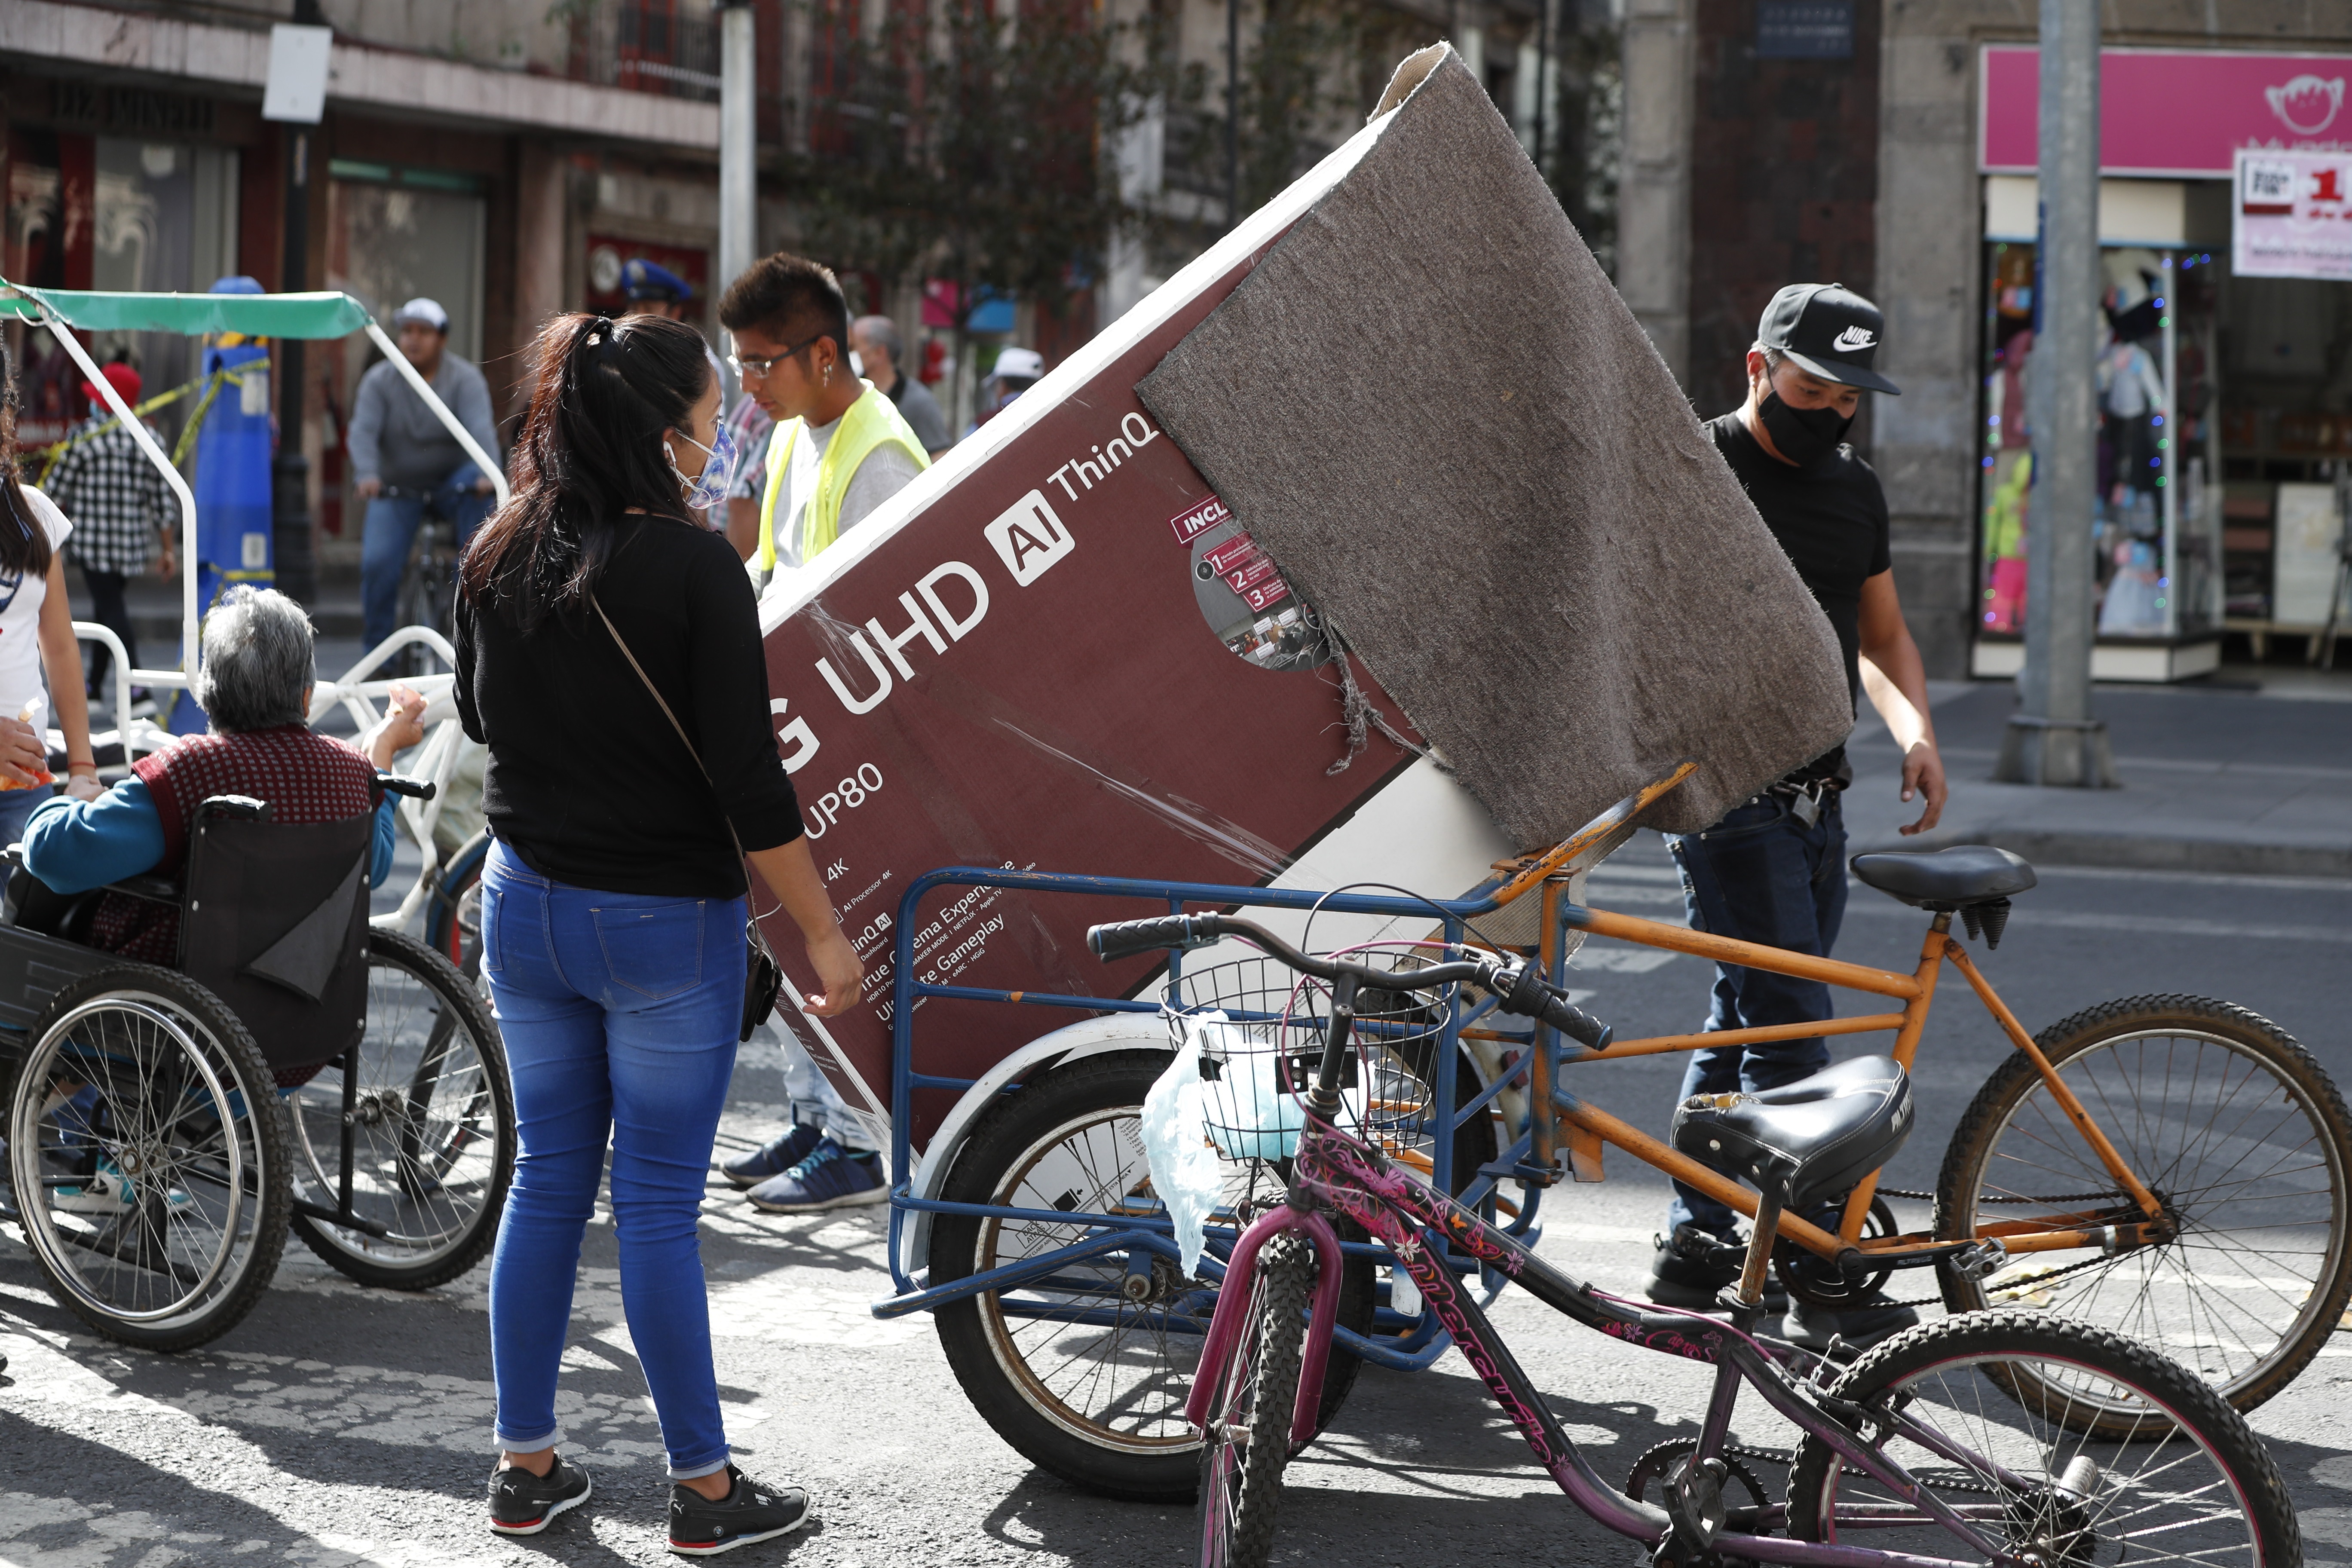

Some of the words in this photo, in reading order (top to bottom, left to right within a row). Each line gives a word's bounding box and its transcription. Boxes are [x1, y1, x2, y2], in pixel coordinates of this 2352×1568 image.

[1843, 325, 1873, 344] NIKE
[1183, 502, 1228, 534] INCL
[815, 561, 989, 715] UHD
[1007, 505, 1061, 573] AI
[1046, 411, 1160, 502] ThinQ
[1211, 554, 1223, 570] 1
[1231, 570, 1247, 589] 2
[1245, 563, 1258, 573] Solicita
[1269, 582, 1283, 593] solicitud
[1250, 589, 1265, 606] 3
[1262, 581, 1277, 591] Disfruta
[1270, 586, 1286, 597] contenido
[803, 763, 883, 839] UP80
[827, 858, 850, 881] 4K
[843, 902, 852, 913] AI
[850, 879, 882, 906] Processor
[882, 869, 892, 880] 4K
[860, 936, 889, 962] Dashboard
[866, 985, 886, 1004] HDR10
[913, 946, 933, 967] MAKER
[931, 933, 949, 950] MODE
[953, 910, 977, 931] NETFLIX
[980, 894, 995, 910] Apple
[993, 888, 1002, 897] TV
[937, 913, 1004, 971] Gameplay
[911, 995, 928, 1013] imizer
[952, 963, 968, 978] eARC
[970, 947, 986, 962] HGiG
[1109, 1180, 1120, 1191] ESTA
[1023, 1220, 1041, 1237] BACK
[1032, 1243, 1044, 1256] CLAMP
[1054, 1227, 1065, 1237] THIS
